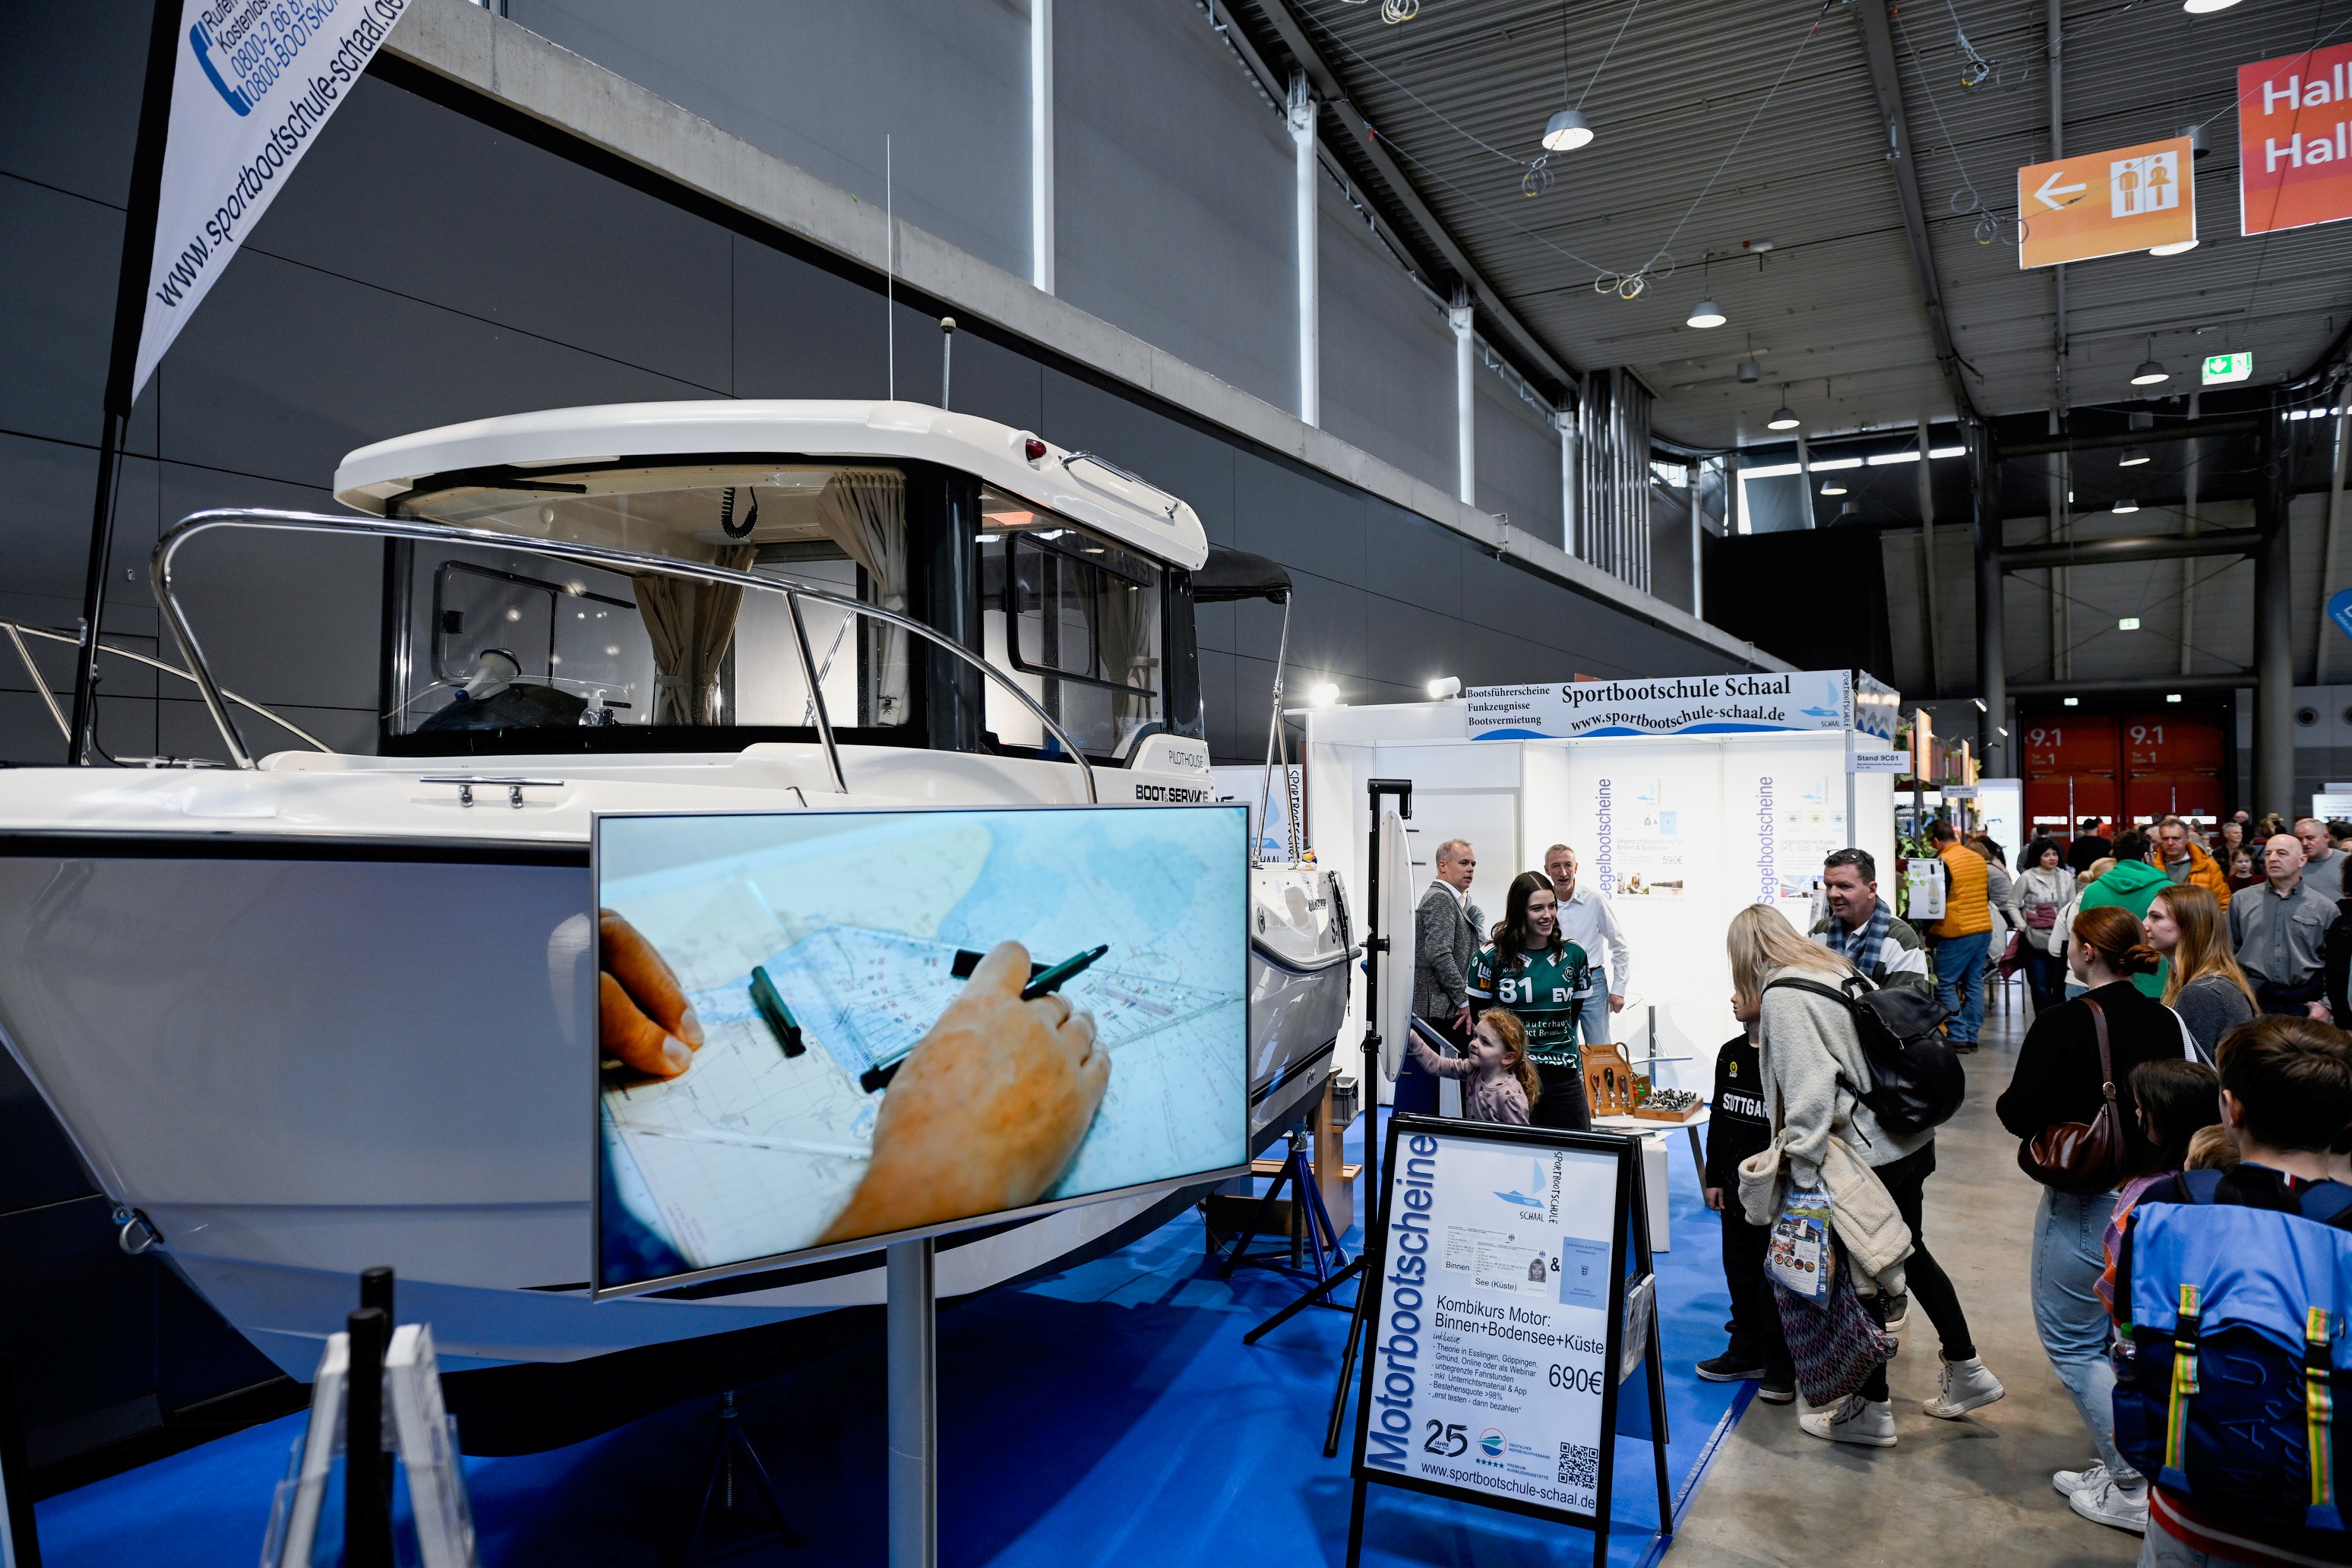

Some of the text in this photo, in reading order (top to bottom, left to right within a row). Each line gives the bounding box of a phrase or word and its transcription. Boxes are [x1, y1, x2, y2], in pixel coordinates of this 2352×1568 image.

[231, 22, 277, 78] 0800-2
[270, 4, 290, 33] 66
[2265, 121, 2352, 173] Hal
[1467, 687, 1550, 698] Bootsführerscheine
[1562, 675, 1791, 708] Sportbootschule Schaal
[1842, 671, 1851, 727] SPORTBOOTSCHULE
[1468, 701, 1530, 713] Funkzeugnisse
[1571, 705, 1785, 731] www.sportbootschule-schaal.de
[1468, 715, 1541, 726] Bootsvermietung
[2031, 727, 2062, 747] 9.1
[2129, 725, 2163, 745] 9.1
[1168, 750, 1203, 768] PILOTHOUSE
[1756, 776, 1778, 904] Segelbootscheine
[1663, 856, 1683, 865] 590€
[1499, 977, 1533, 1003] 81
[1723, 1092, 1769, 1119] STUTTGAR
[1549, 1151, 1563, 1225] SPORTBOOTSCHULE
[1519, 1211, 1544, 1222] SCHAAL
[1446, 1261, 1470, 1271] Binnen
[1551, 1257, 1560, 1272] &
[1475, 1278, 1489, 1287] See
[1491, 1280, 1517, 1291] (Küste)
[1367, 1135, 1437, 1471] Motorbootscheine
[1437, 1295, 1551, 1327] Kombikurs Motor:
[1435, 1313, 1604, 1355] Binnen+Bodensee+Küste
[1436, 1352, 1536, 1378] Gmünd, Online oder als Webinar
[1437, 1344, 1460, 1355] Theorie
[1461, 1347, 1467, 1355] in
[1468, 1348, 1500, 1363] Esslingen,
[1502, 1354, 1538, 1369] Göppingen,
[1434, 1371, 1446, 1381] inkl.
[1448, 1374, 1506, 1392] Unterrichtsmaterial
[1514, 1386, 1527, 1396] App
[1435, 1363, 1473, 1378] unbegrenzte
[1475, 1369, 1514, 1383] Fahrstunden
[1549, 1364, 1604, 1395] 690€
[1433, 1381, 1483, 1398] Bestehensquote
[1484, 1390, 1503, 1400] >98%
[1448, 1393, 1467, 1404] testen
[1472, 1398, 1488, 1408] dann
[1424, 1419, 1468, 1457] 25
[1509, 1443, 1532, 1451] DEUTSCHER
[1508, 1448, 1551, 1459] MOTORYACHTVERBAND
[1421, 1462, 1595, 1509] www.sportbootschule-schaal.de
[1506, 1468, 1549, 1481] AUSBILDUNGSSTÄTTE
